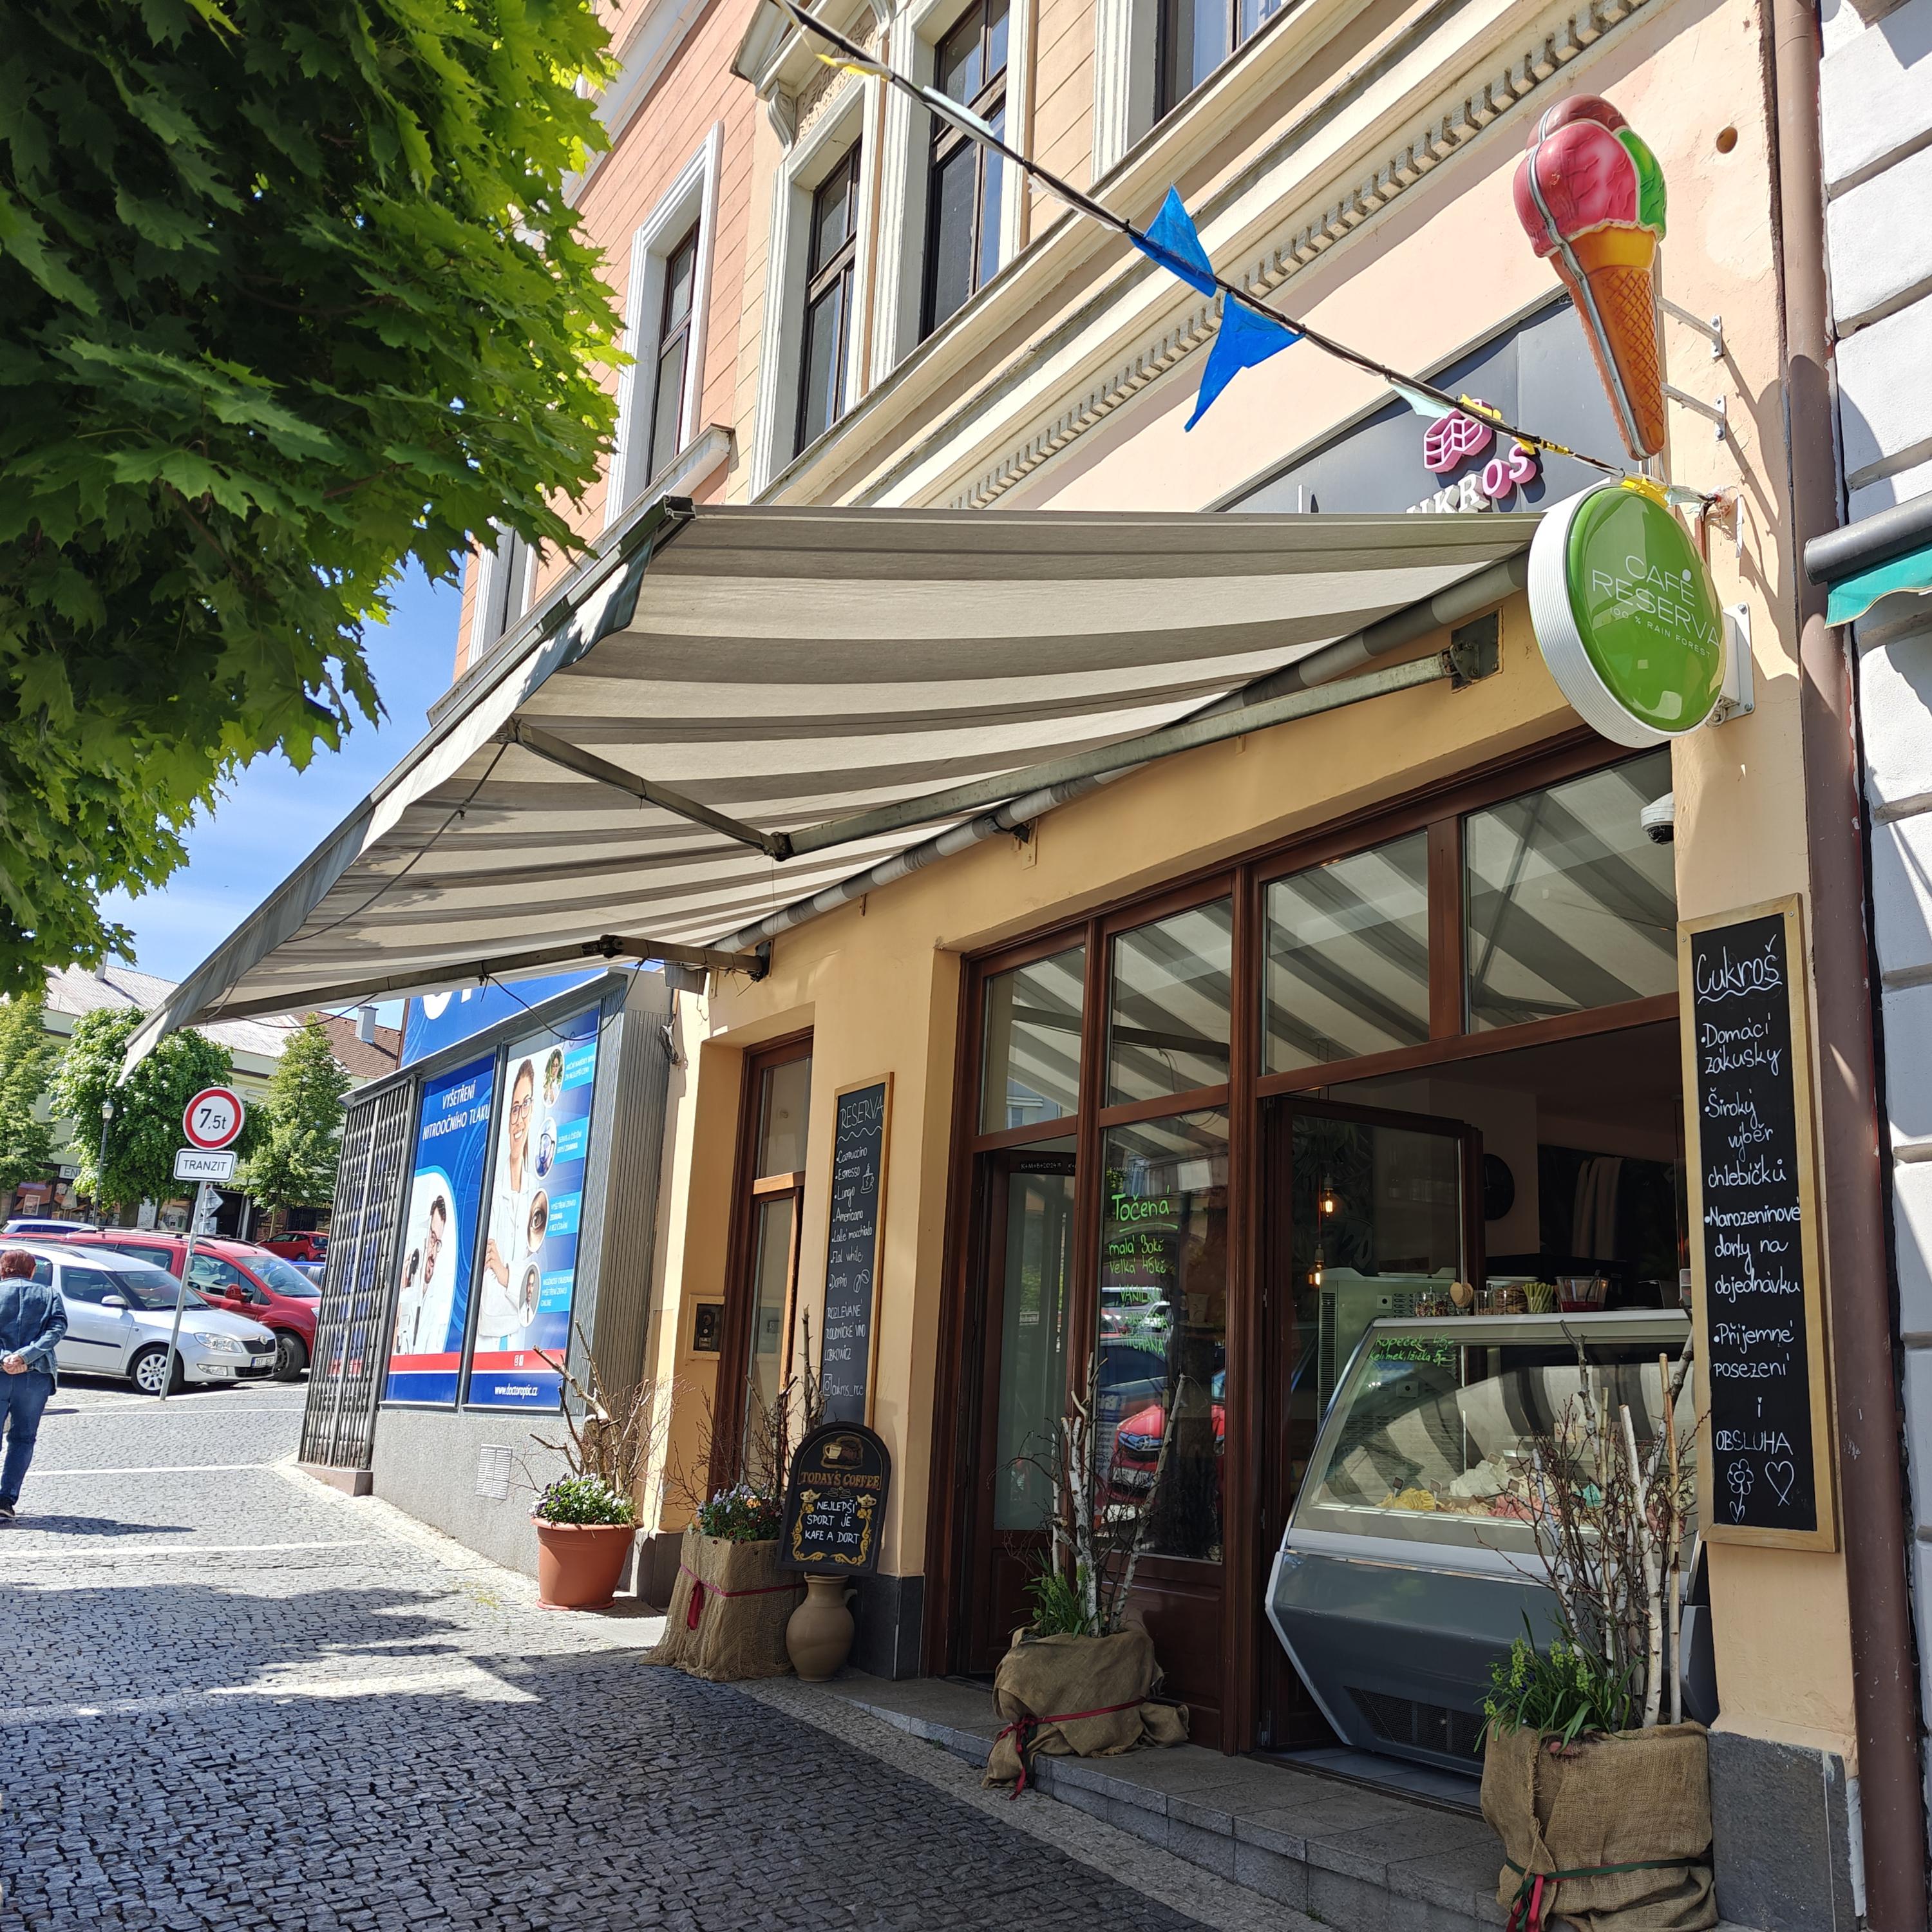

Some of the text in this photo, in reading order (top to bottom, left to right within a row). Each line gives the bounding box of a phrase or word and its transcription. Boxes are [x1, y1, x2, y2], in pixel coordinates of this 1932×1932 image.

[1592, 569, 1719, 647] RESERVA
[1647, 621, 1671, 638] RAIN
[1675, 634, 1710, 658] FOREST
[1703, 1012, 1772, 1048] Domácí
[442, 1079, 477, 1110] VYŠETŘENÍ
[198, 1108, 227, 1130] 7,5t
[422, 1103, 491, 1141] NITROOČNÍHO TLAKU
[840, 1094, 884, 1130] RESERVA
[1727, 1122, 1774, 1162] výběr
[184, 1160, 227, 1171] TRANZIT
[837, 1186, 855, 1207] Lungo
[1111, 1185, 1170, 1222] Točená
[1108, 1235, 1135, 1256] malá
[1760, 1238, 1788, 1253] na
[1716, 1430, 1794, 1455] OBSLUHA
[800, 1470, 880, 1490] TODAY'S COFFEE
[817, 1499, 857, 1513] NEJLEPŠÍ
[806, 1514, 852, 1527] SPORT JE
[805, 1530, 860, 1544] KAFE A DORT
